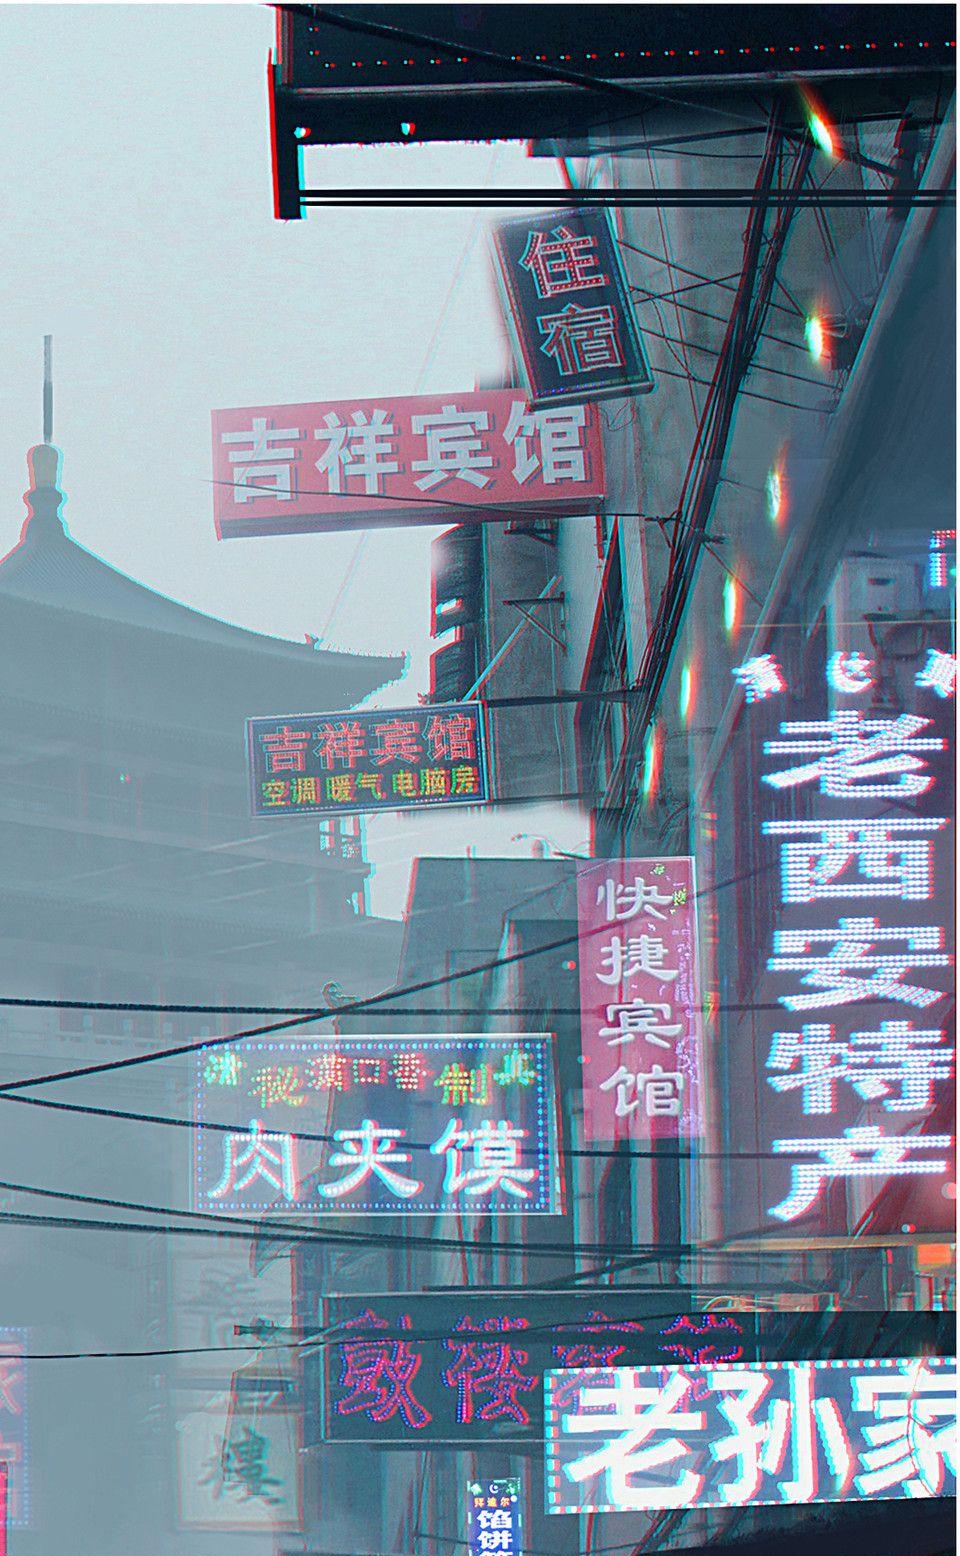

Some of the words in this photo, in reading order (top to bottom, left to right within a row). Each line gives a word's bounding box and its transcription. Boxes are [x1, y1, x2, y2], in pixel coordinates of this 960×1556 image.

[518, 223, 624, 378] 住宿
[220, 402, 589, 505] 吉祥宾馆
[259, 713, 478, 774] 吉祥宾馆
[261, 777, 321, 808] 空调
[326, 770, 386, 803] 暖气
[392, 764, 481, 798] 电脑房
[596, 876, 684, 1118] 快捷宾馆
[762, 710, 955, 1222] 老西安特产
[207, 1118, 540, 1201] 肉夹馍
[561, 1362, 957, 1509] 老孙家
